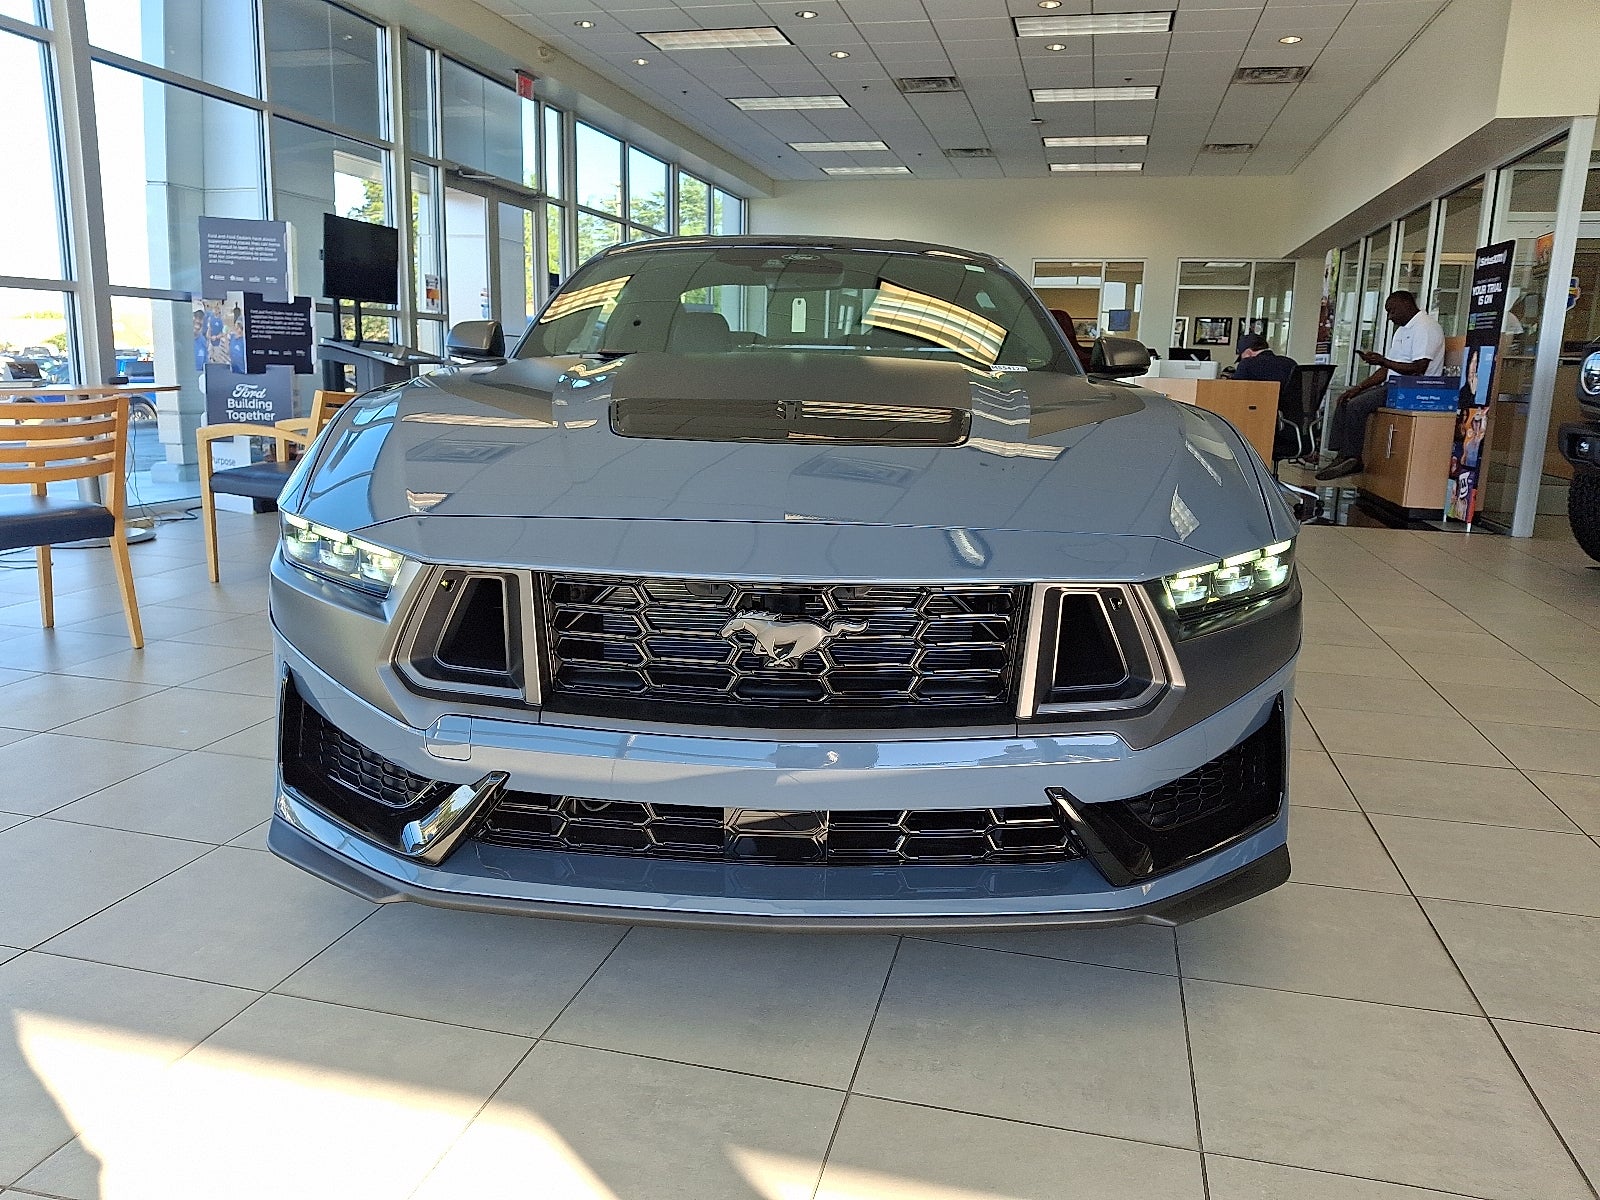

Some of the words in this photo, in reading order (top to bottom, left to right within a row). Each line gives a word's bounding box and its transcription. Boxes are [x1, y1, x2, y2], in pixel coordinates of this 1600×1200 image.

[1473, 285, 1486, 296] YOUR
[1487, 282, 1502, 293] TRIAL
[1478, 295, 1484, 305] IS
[1484, 294, 1493, 304] ON
[232, 384, 266, 398] Ford
[227, 399, 272, 411] Building
[226, 410, 275, 422] Together
[213, 457, 236, 466] urpose
